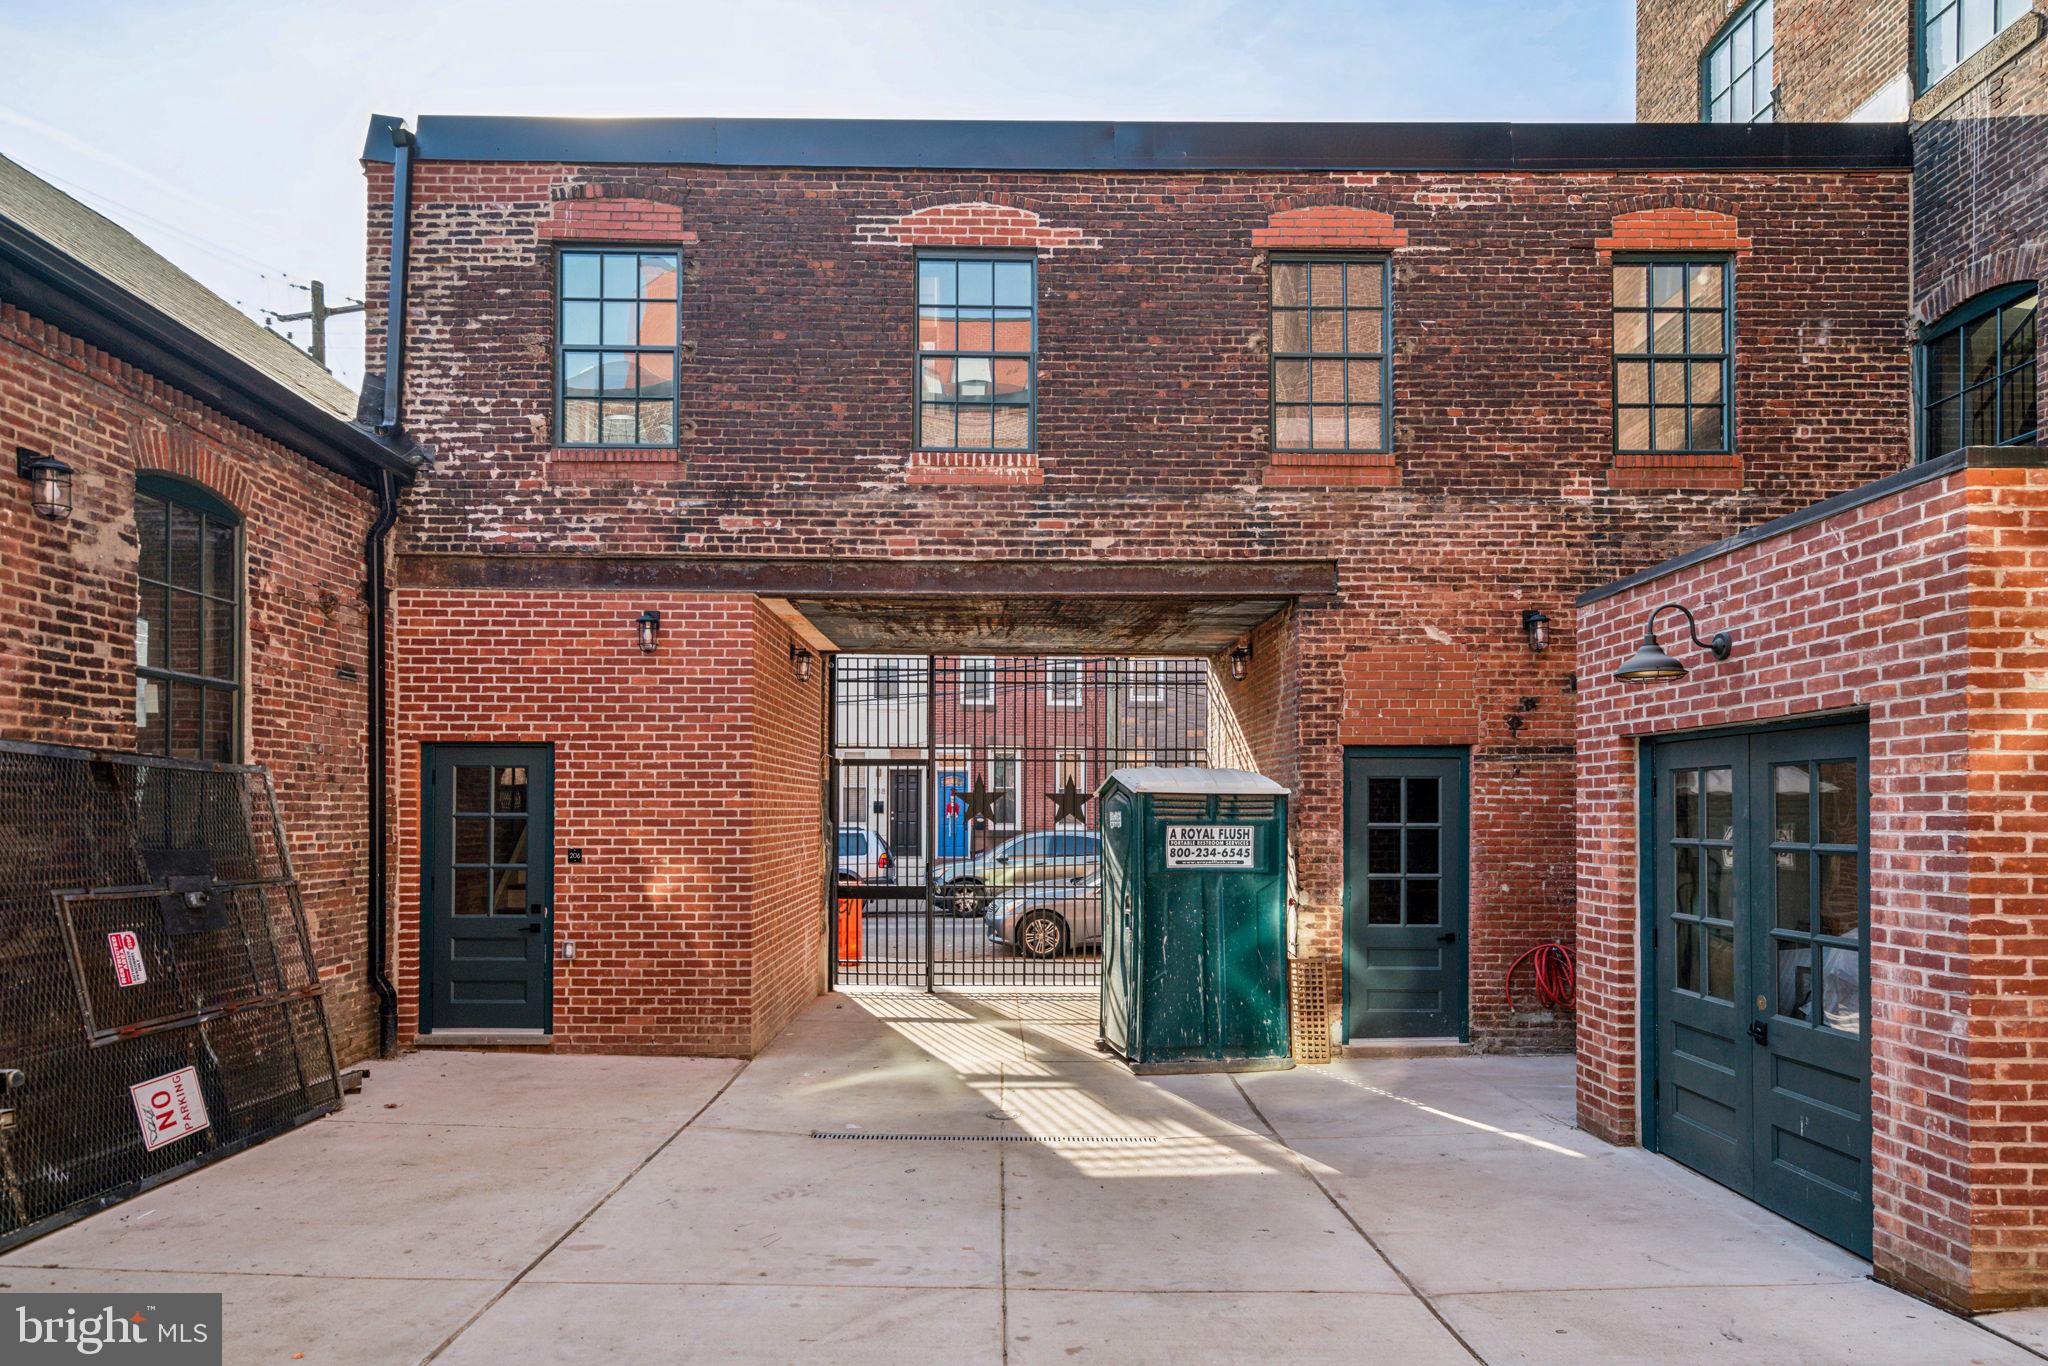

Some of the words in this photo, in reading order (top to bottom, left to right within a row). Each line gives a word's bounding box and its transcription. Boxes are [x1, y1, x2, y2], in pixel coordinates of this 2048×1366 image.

[1169, 828, 1177, 840] A
[1181, 828, 1215, 840] ROYAL
[1219, 828, 1250, 840] FLUSH
[1170, 848, 1250, 858] 800-234-6545
[111, 935, 128, 984] RESTRICTED
[119, 949, 129, 970] AREA
[151, 1090, 178, 1131] NO
[172, 1075, 194, 1131] PARKING
